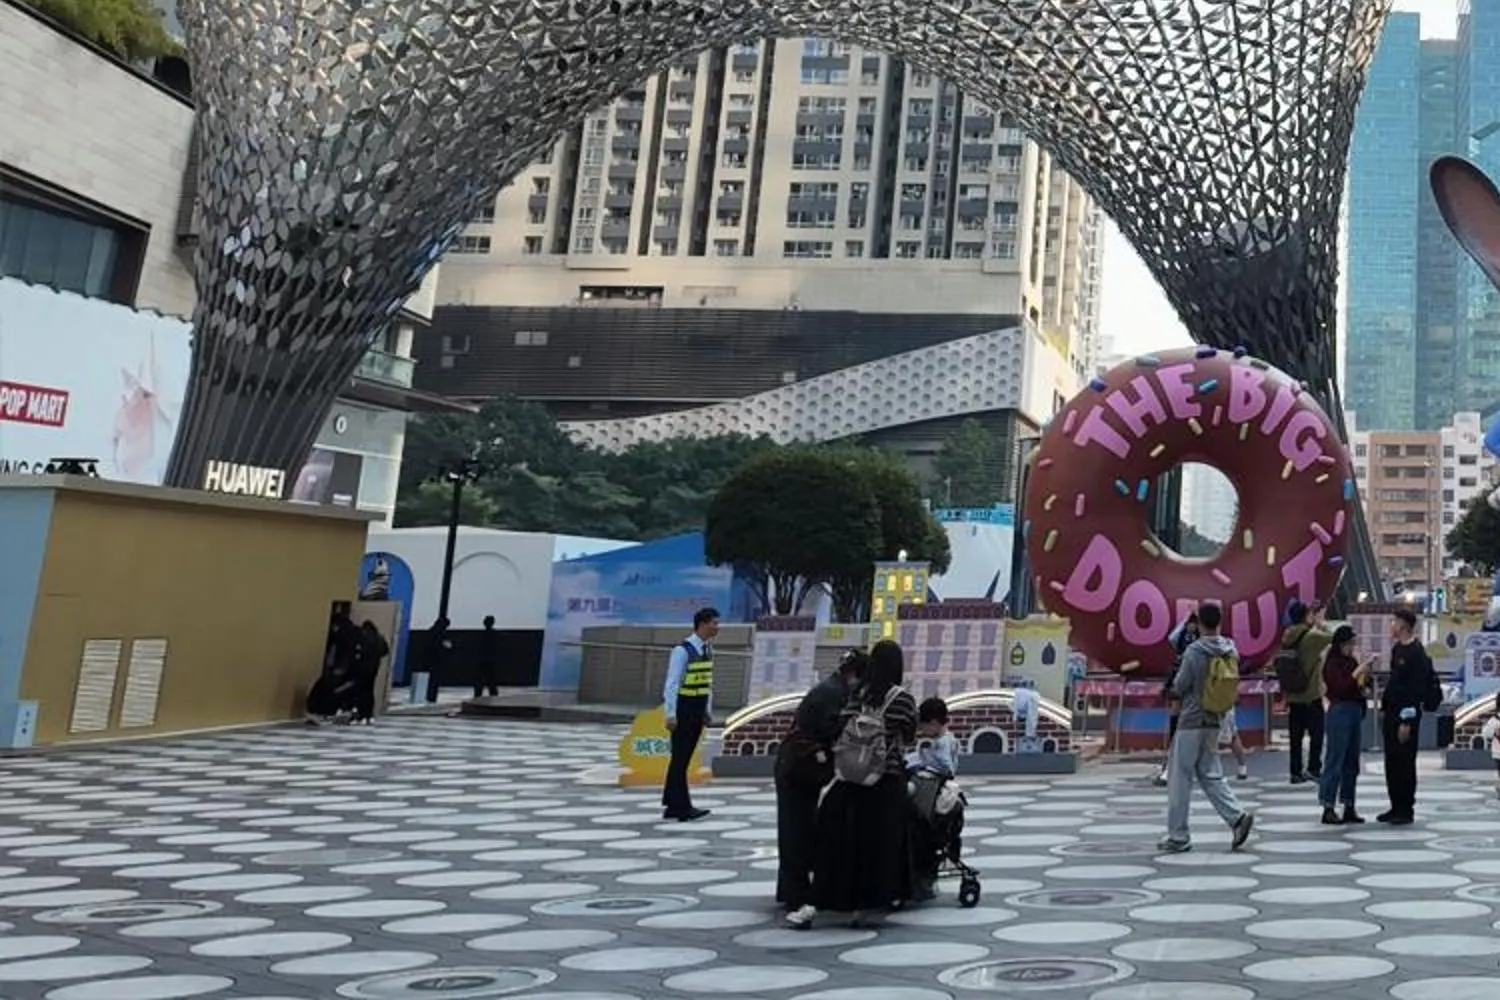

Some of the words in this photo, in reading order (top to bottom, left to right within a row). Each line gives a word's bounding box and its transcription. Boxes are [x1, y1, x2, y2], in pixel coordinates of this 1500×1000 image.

[0, 385, 27, 417] POP
[26, 391, 65, 424] MART
[1074, 363, 1201, 459] THE
[1228, 364, 1327, 472] BIG
[205, 460, 286, 498] HUAWEI
